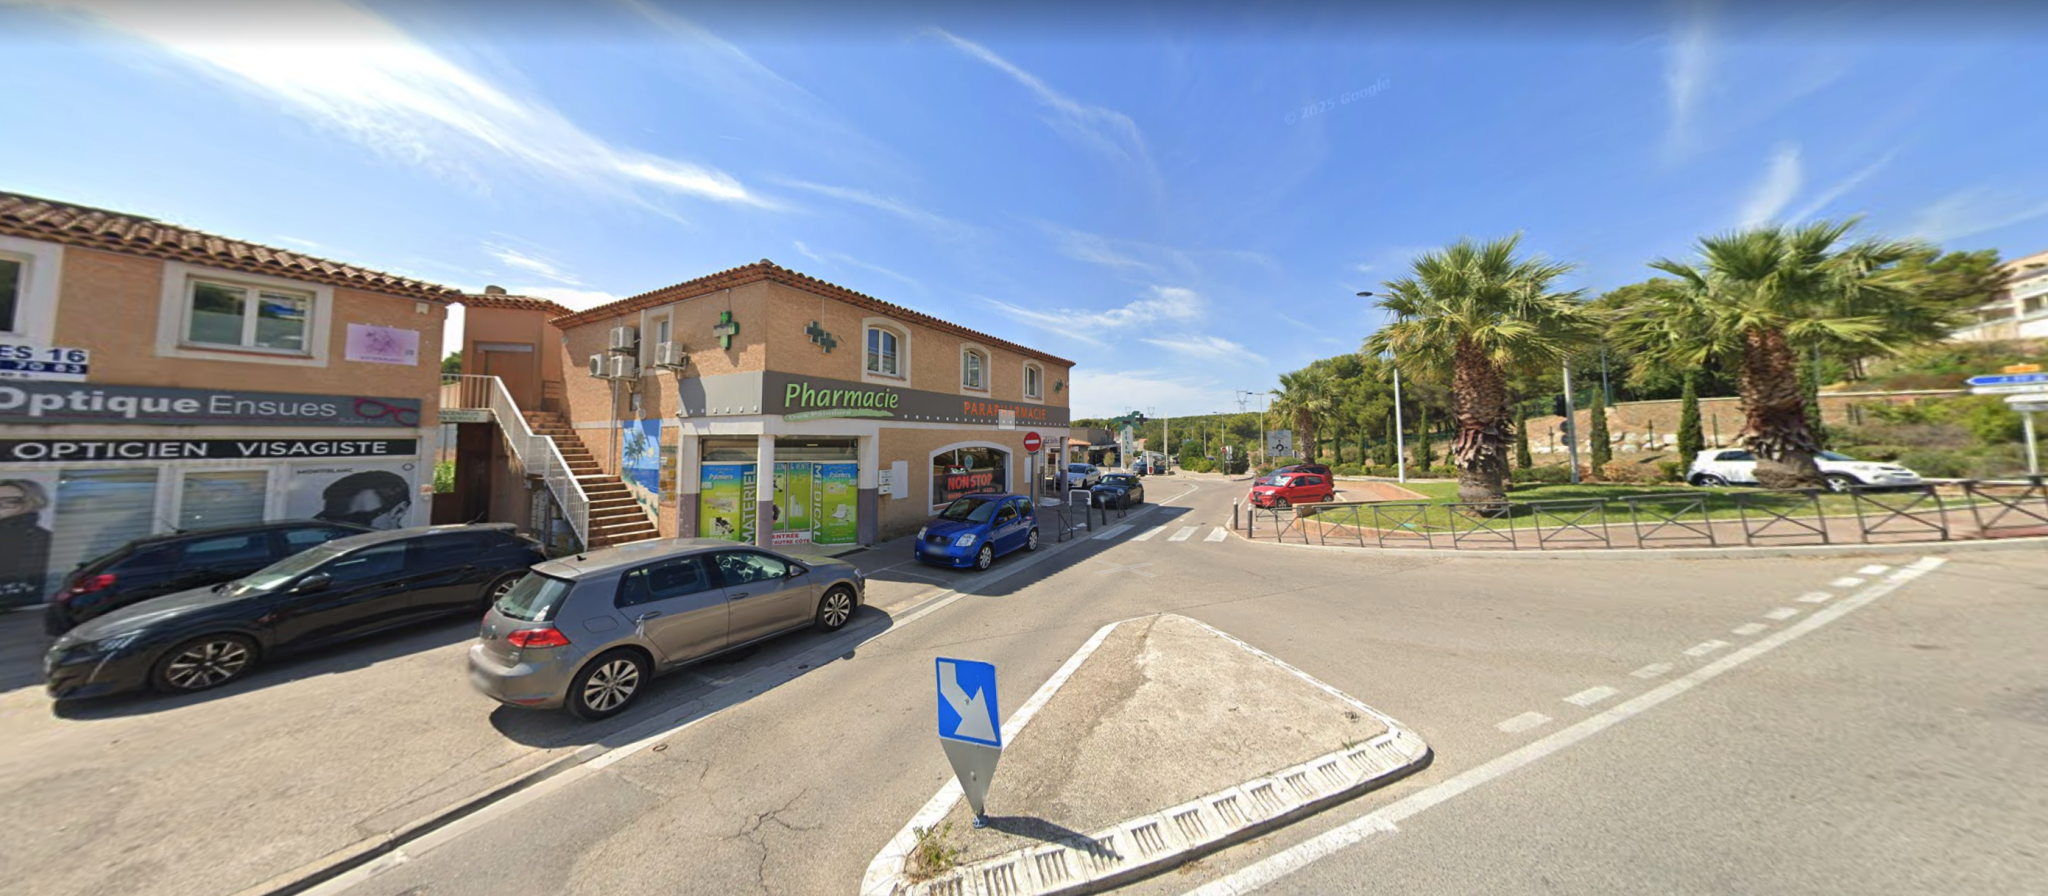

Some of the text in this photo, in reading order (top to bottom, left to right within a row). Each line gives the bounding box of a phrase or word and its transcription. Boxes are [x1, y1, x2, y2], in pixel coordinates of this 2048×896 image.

[47, 349, 86, 363] 16
[16, 361, 83, 373] 70 83
[0, 386, 337, 417] Optique Ensues
[784, 382, 898, 408] Pharmacie
[811, 408, 852, 417] Palmiers
[963, 401, 1047, 420] PARAPHARMACIE
[13, 441, 387, 459] OPTICIEN VISAGISTE
[948, 475, 970, 491] NON
[970, 473, 993, 488] STOP
